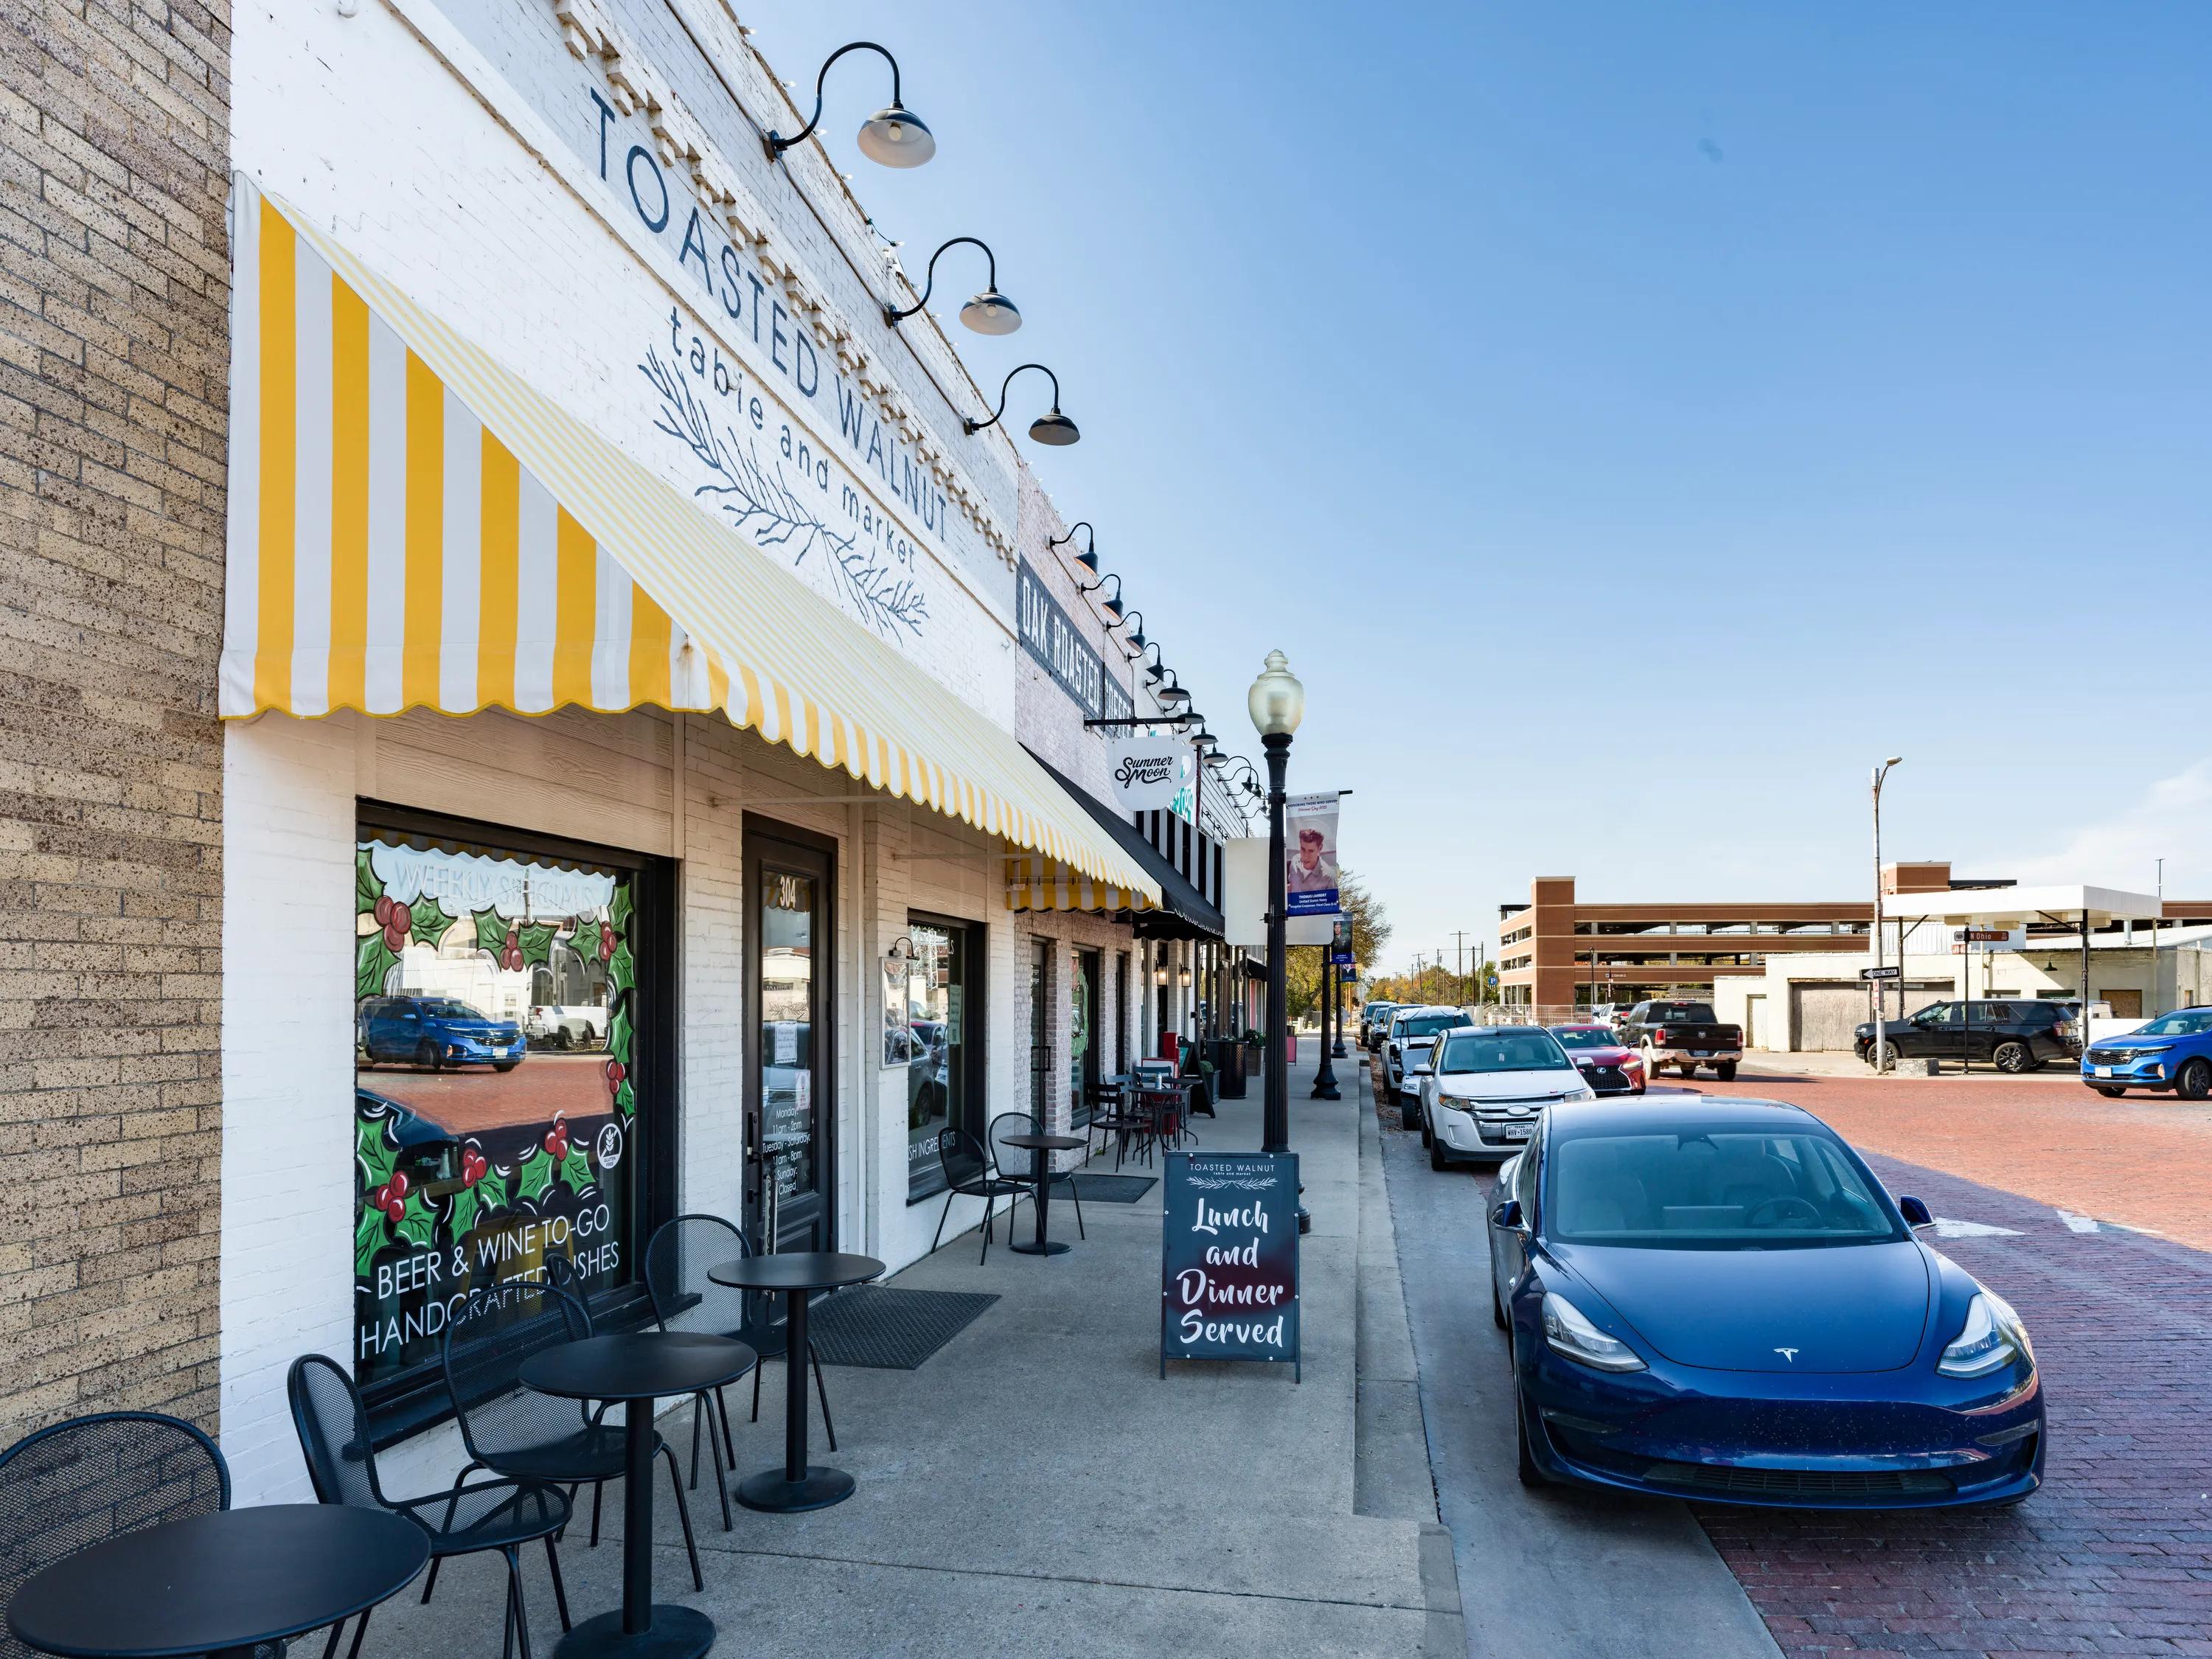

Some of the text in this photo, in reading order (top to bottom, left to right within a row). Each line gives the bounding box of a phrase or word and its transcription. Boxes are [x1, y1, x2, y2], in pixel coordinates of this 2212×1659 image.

[591, 87, 947, 543] TOASTED WALNUT
[780, 424, 828, 493] and
[841, 482, 916, 573] market
[1023, 575, 1048, 659] OAK
[1054, 614, 1099, 715] ROASTED
[1115, 756, 1173, 782] Summer
[1124, 768, 1172, 789] Moon
[779, 875, 796, 908] 304
[773, 1124, 787, 1135] 11am
[790, 1121, 801, 1133] 2pm
[776, 1107, 799, 1119] Monday:
[762, 1141, 784, 1154] Tuesday
[787, 1133, 810, 1147] Saturday:
[790, 1150, 801, 1162] 8pm
[776, 1166, 798, 1180] Sunday:
[778, 1180, 796, 1195] Closed
[1192, 1197, 1268, 1236] Lunch
[378, 1204, 610, 1300] BEER & WINE TO-GO
[1206, 1237, 1259, 1268] and
[1176, 1268, 1284, 1305] Dinner
[1180, 1309, 1284, 1348] Served
